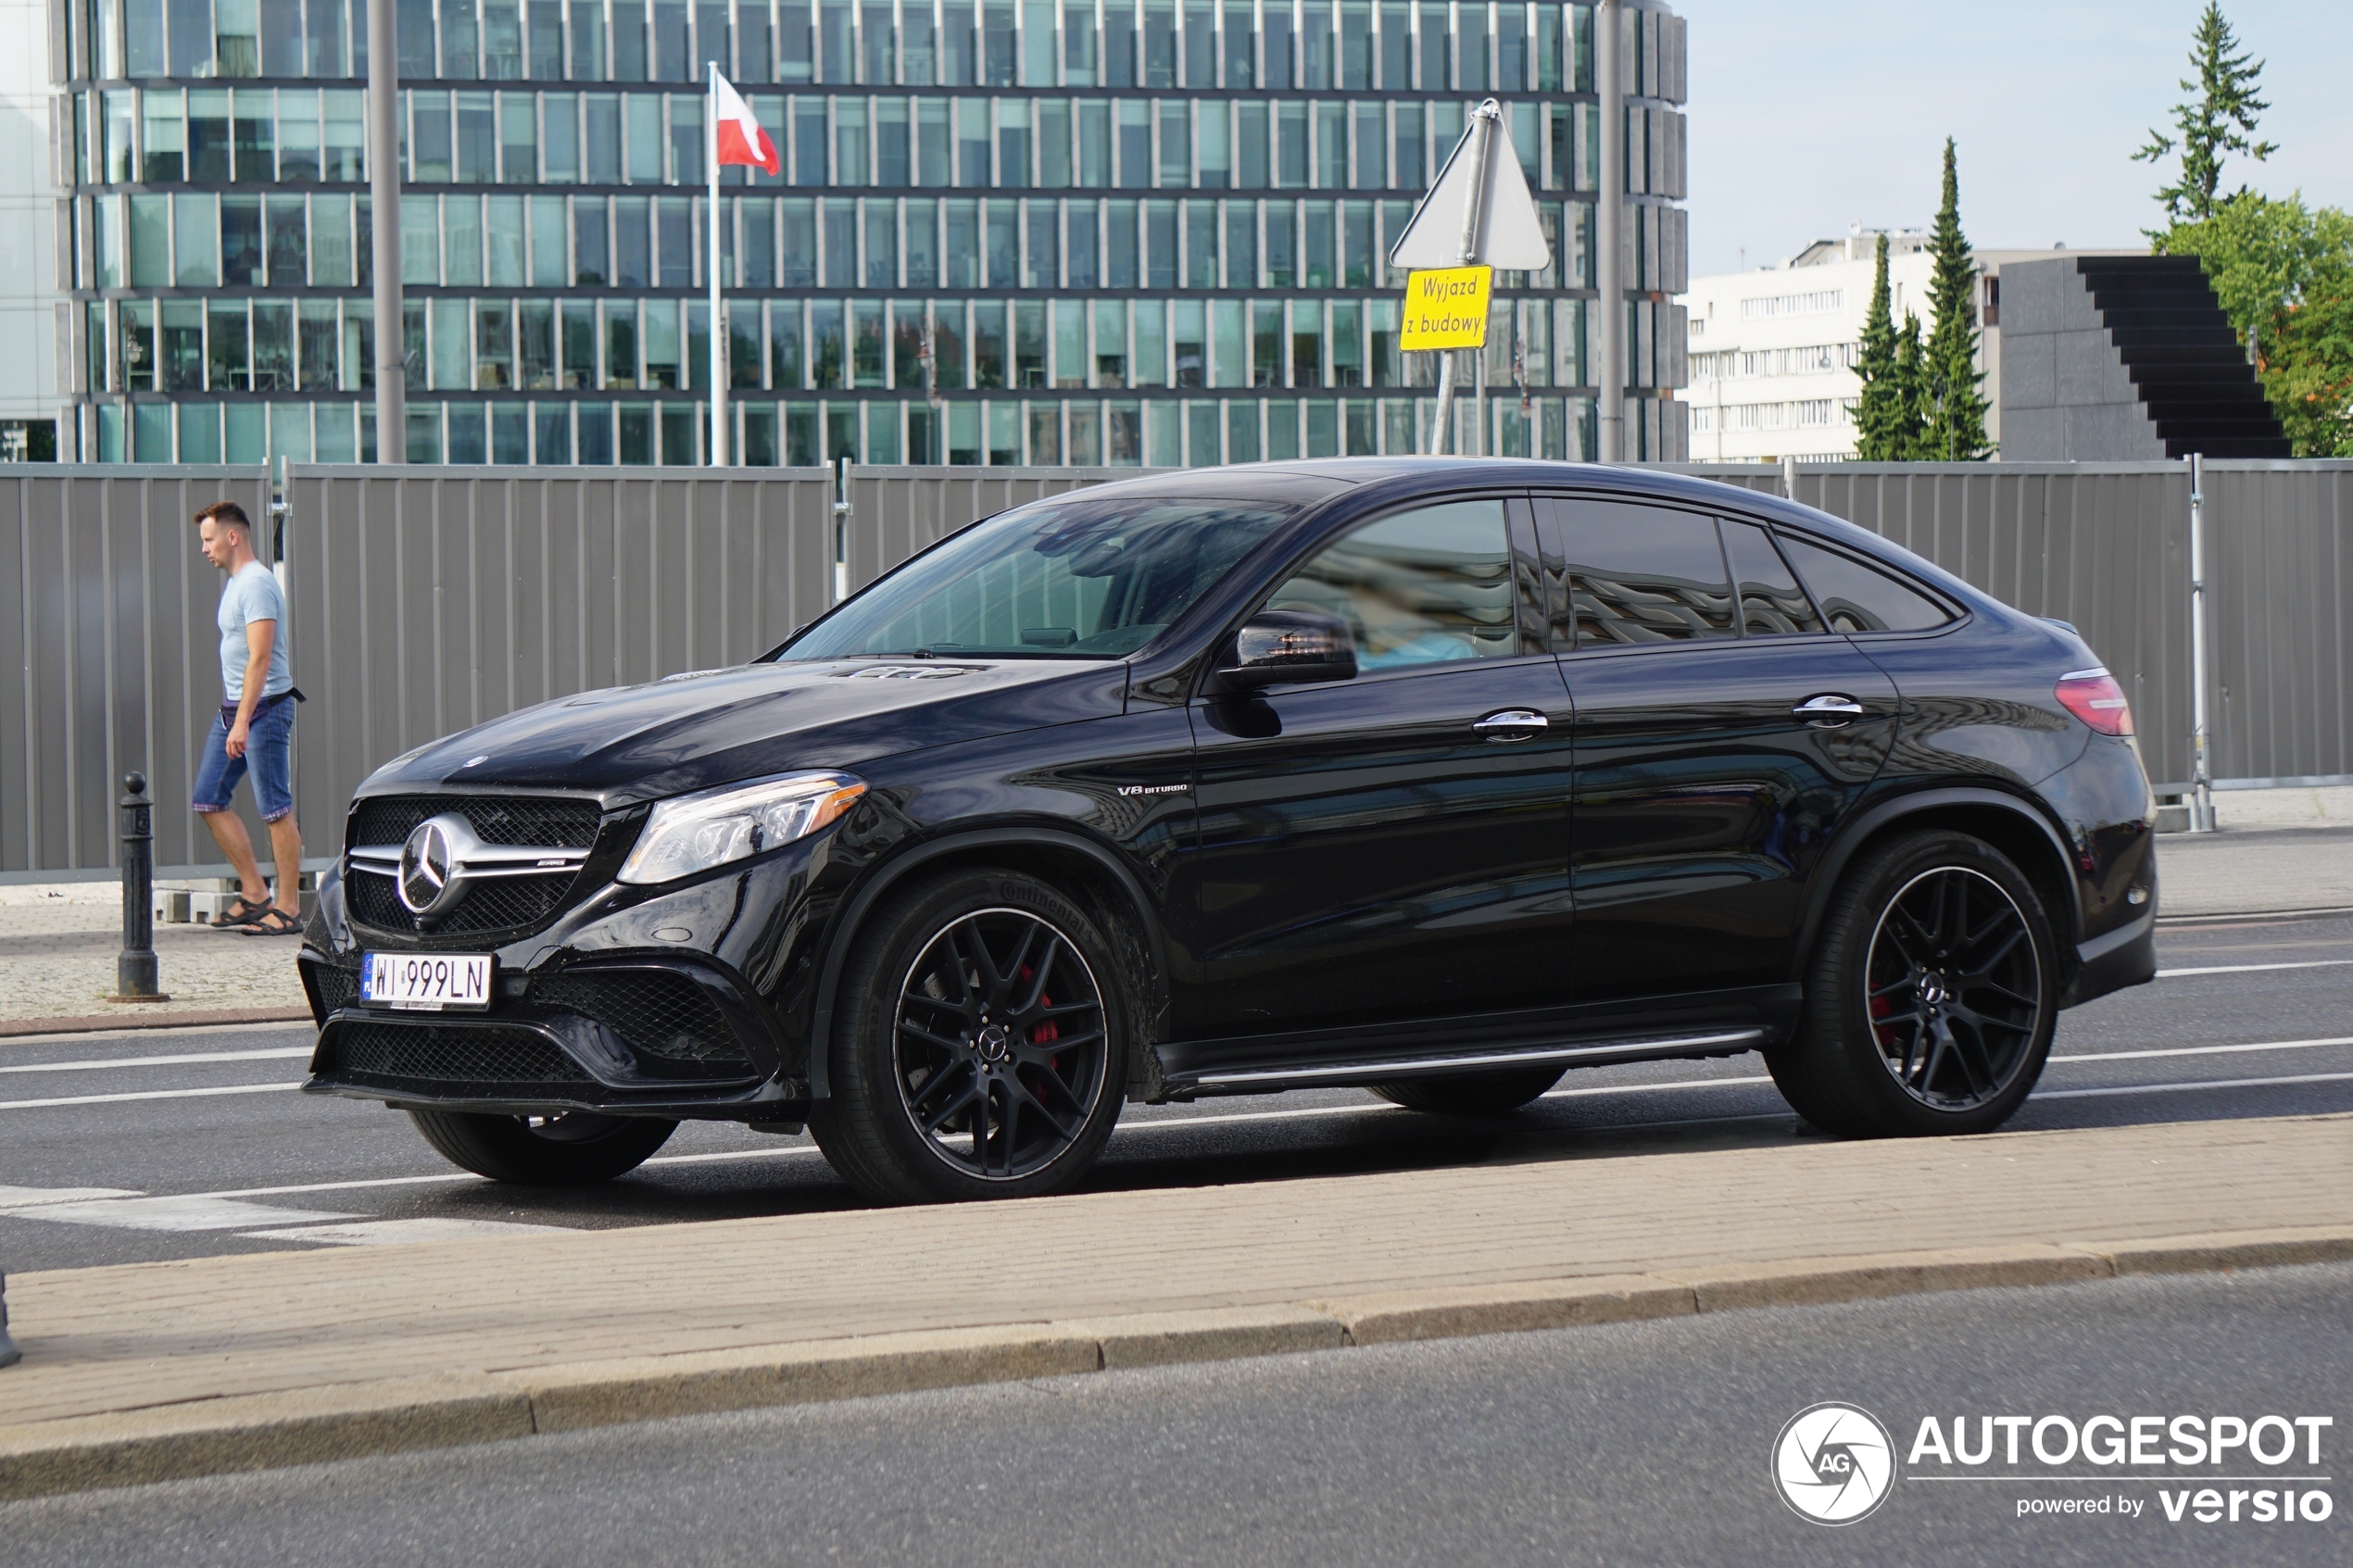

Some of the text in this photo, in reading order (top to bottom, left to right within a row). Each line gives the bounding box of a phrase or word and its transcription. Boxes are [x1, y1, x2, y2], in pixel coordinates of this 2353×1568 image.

[1423, 274, 1478, 303] Wyjazd
[1406, 312, 1481, 337] z budowy
[1117, 784, 1188, 797] V8 BITURBO
[1000, 881, 1086, 935] Continental
[376, 959, 484, 998] WI 999LN
